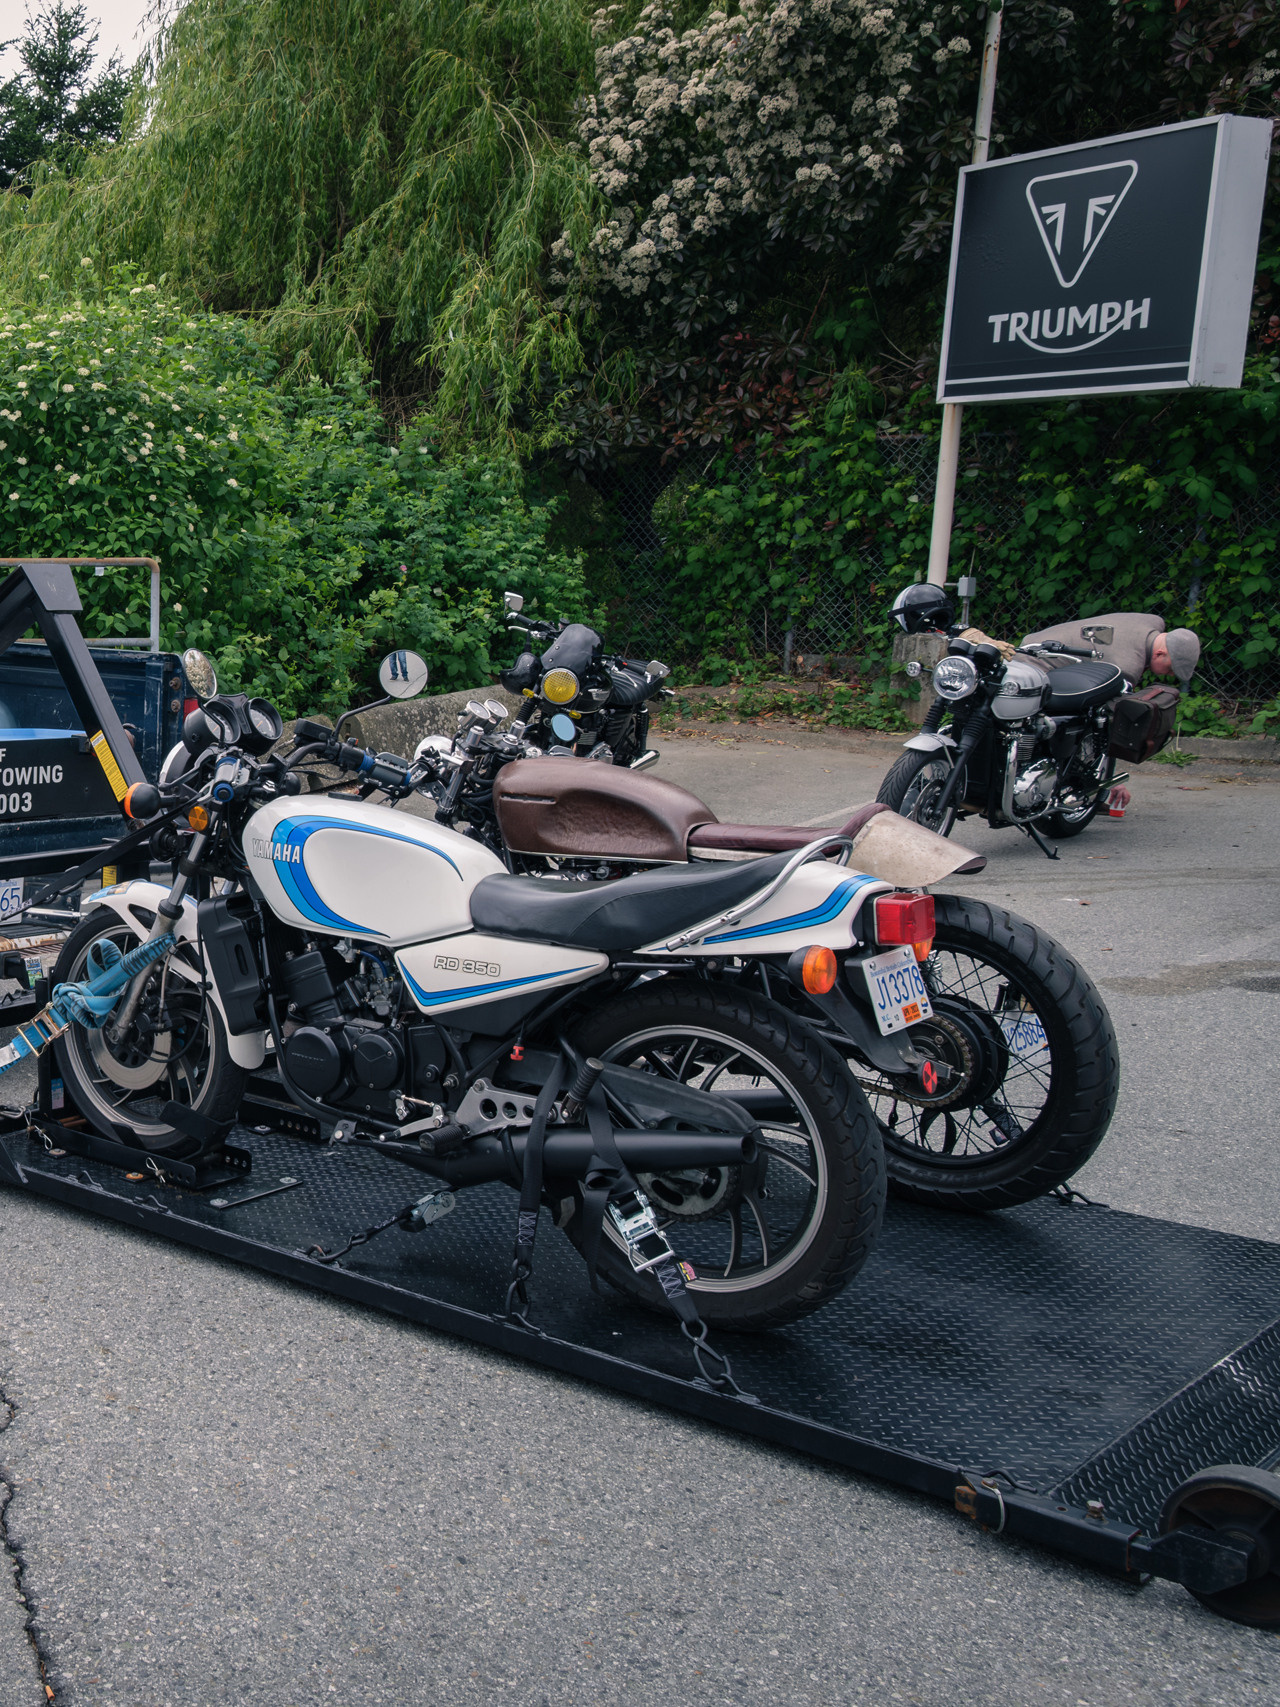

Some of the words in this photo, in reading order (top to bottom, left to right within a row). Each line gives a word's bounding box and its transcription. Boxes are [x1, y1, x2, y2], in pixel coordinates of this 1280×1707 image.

[988, 298, 1151, 354] TRIUMPH
[252, 838, 300, 864] YAMAHA
[434, 955, 459, 971] RD
[462, 959, 501, 977] 350
[876, 965, 924, 1010] J13378
